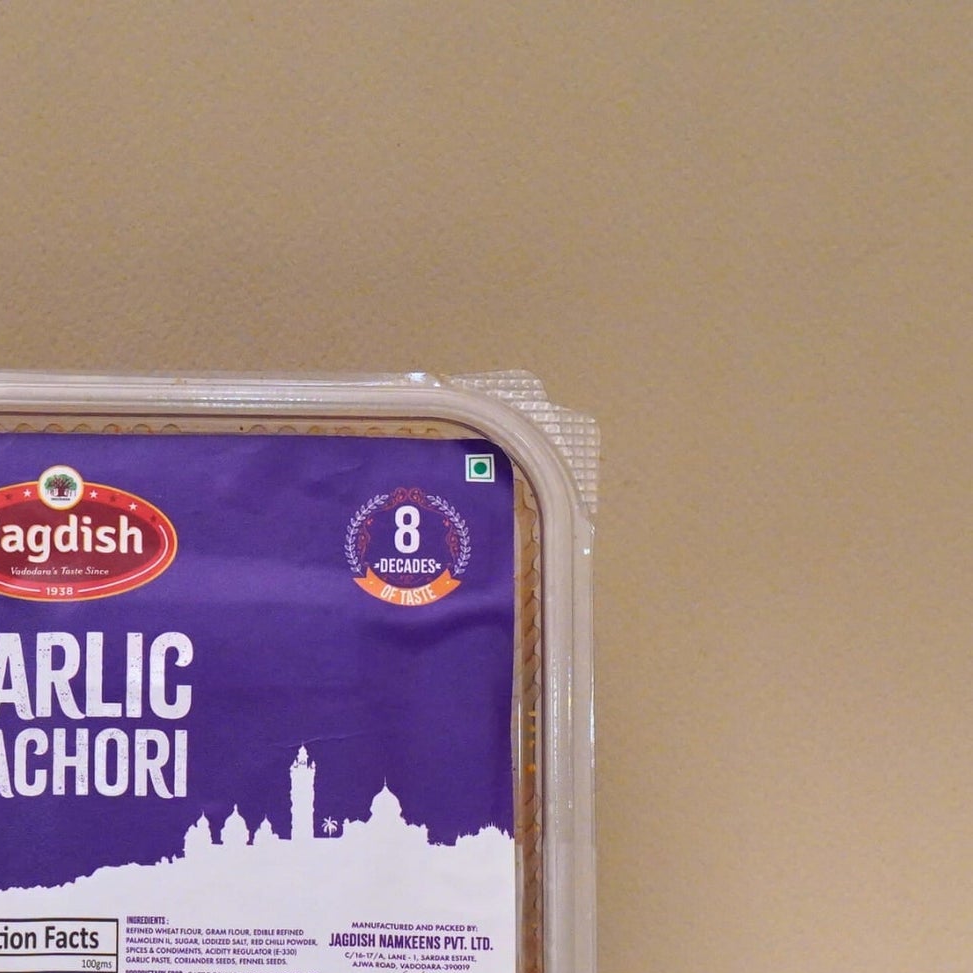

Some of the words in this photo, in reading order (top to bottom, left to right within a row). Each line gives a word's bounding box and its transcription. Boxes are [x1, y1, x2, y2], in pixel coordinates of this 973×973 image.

[394, 505, 420, 554] 8
[380, 558, 436, 574] DECADES
[11, 567, 57, 576] Vadodara's
[61, 567, 83, 575] Taste
[86, 567, 109, 575] Since
[46, 587, 73, 596] 1938
[381, 585, 397, 600] OF
[400, 584, 437, 606] TASTE
[352, 922, 414, 931] MANUFACTURED
[46, 926, 99, 949] Facts
[329, 933, 375, 948] JAGDISH
[380, 934, 441, 950] NAMKEENS
[444, 936, 467, 950] PVT.
[471, 937, 493, 951] LTD.
[345, 952, 385, 960] C/16-17/A,
[82, 960, 112, 970] 100gms
[376, 962, 398, 970] ROAD,
